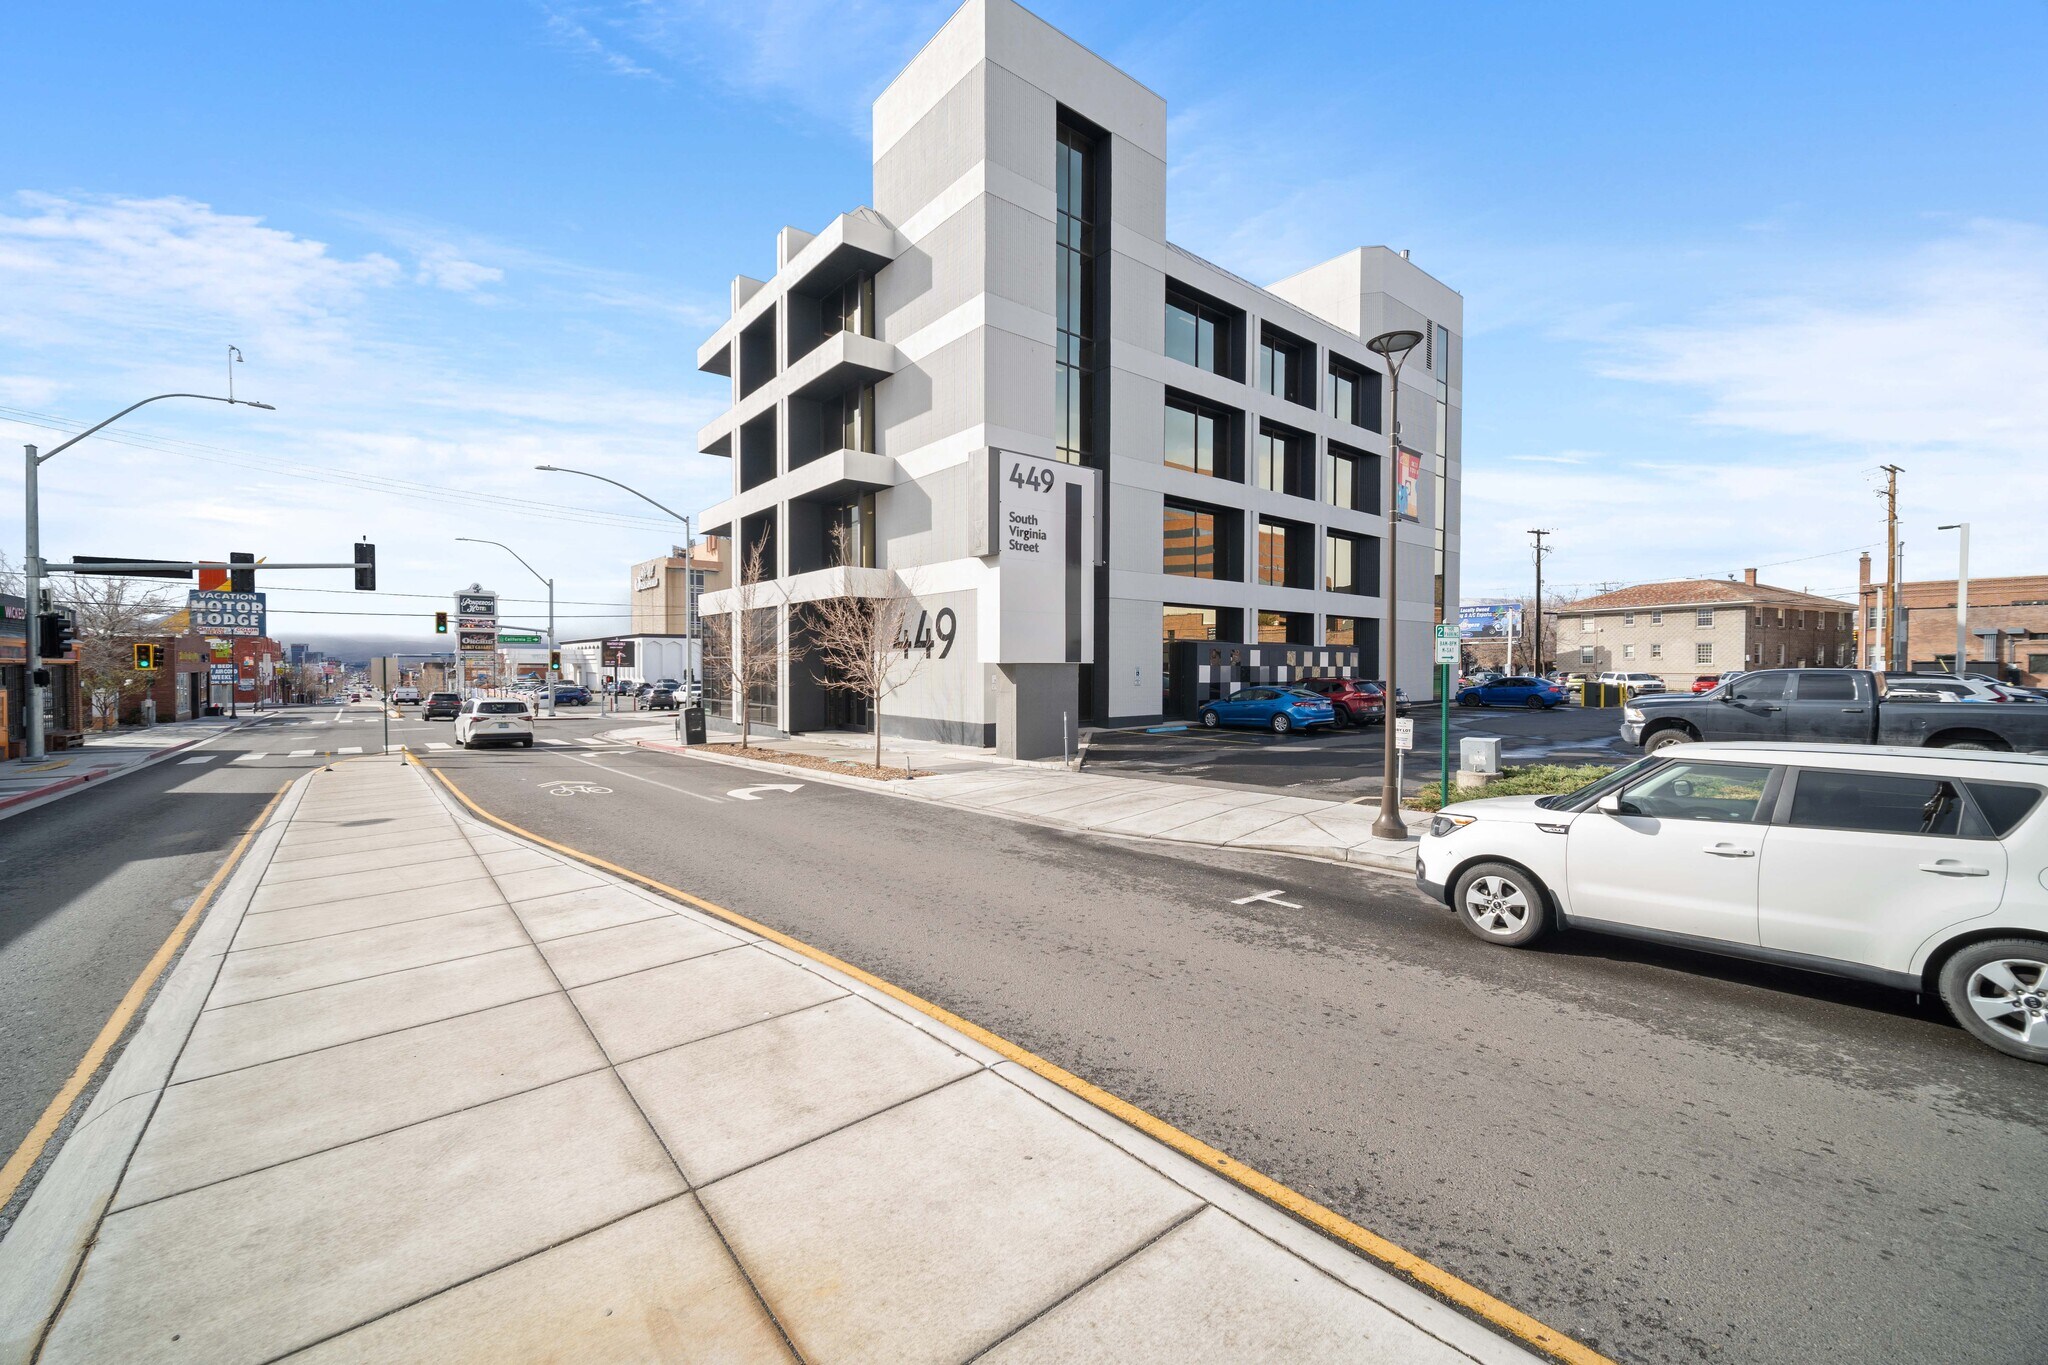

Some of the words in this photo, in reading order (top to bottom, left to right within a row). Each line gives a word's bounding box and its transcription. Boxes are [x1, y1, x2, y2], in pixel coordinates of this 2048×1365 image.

[1009, 463, 1055, 493] 449
[1009, 511, 1038, 526] South
[1009, 525, 1047, 541] Virginia
[1009, 539, 1039, 553] Street
[191, 600, 264, 613] MOTOR
[197, 613, 259, 626] LODGE
[893, 607, 957, 659] 449
[1438, 627, 1443, 637] 2
